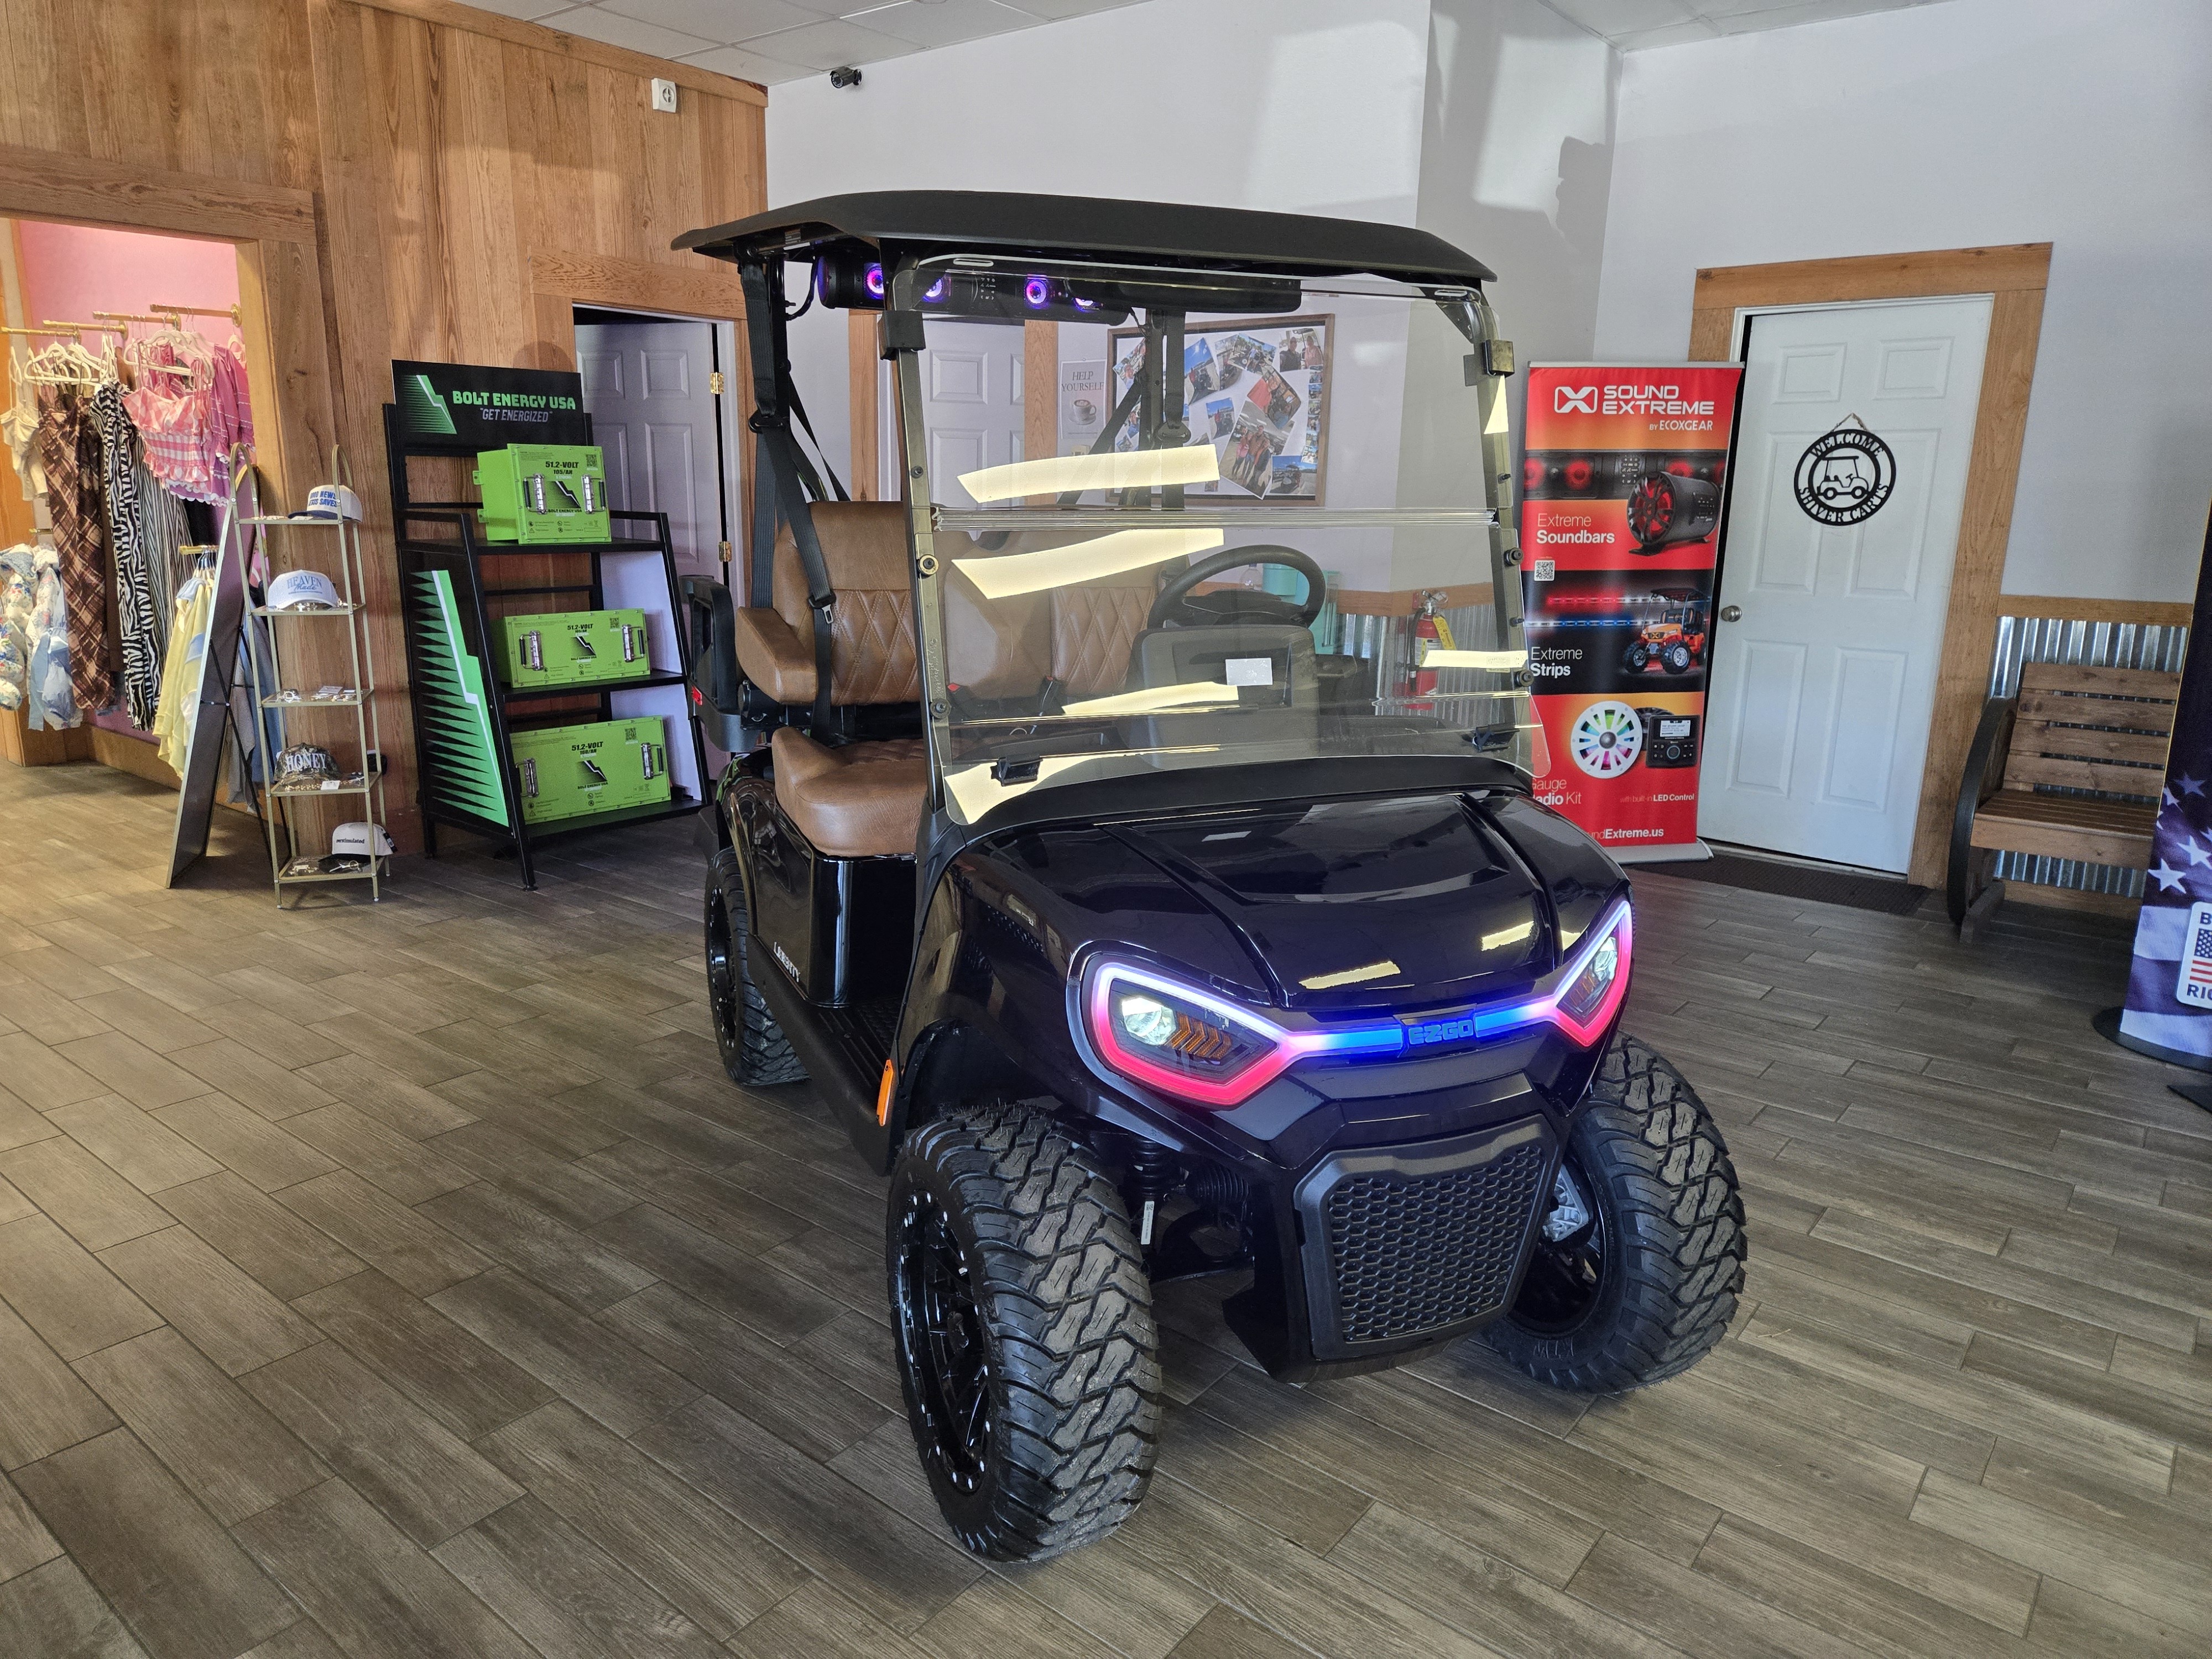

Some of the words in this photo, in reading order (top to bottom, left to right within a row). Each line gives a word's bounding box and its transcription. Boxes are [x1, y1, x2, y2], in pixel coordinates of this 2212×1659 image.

[1072, 371, 1094, 380] HELP
[1061, 382, 1104, 392] YOURSELF
[1604, 385, 1679, 399] SOUND
[452, 390, 489, 405] BOLT
[492, 393, 546, 408] ENERGY
[549, 396, 576, 410] USA
[1602, 400, 1714, 415] EXTREME
[1660, 420, 1713, 431] ECOXGEAR
[1809, 432, 1884, 457] WELCOME
[1850, 483, 1890, 521] CARTS
[1537, 513, 1592, 527] Extreme
[1536, 530, 1615, 544] Soundbars
[286, 575, 322, 589] HEAVEN
[1531, 646, 1583, 660] Extreme
[1530, 662, 1571, 679] Strips
[571, 742, 603, 751] 51.2-VOLT
[285, 753, 326, 772] HONEY
[1533, 792, 1564, 805] adio
[1566, 791, 1582, 805] Kit
[1408, 1020, 1474, 1045] EZGO
